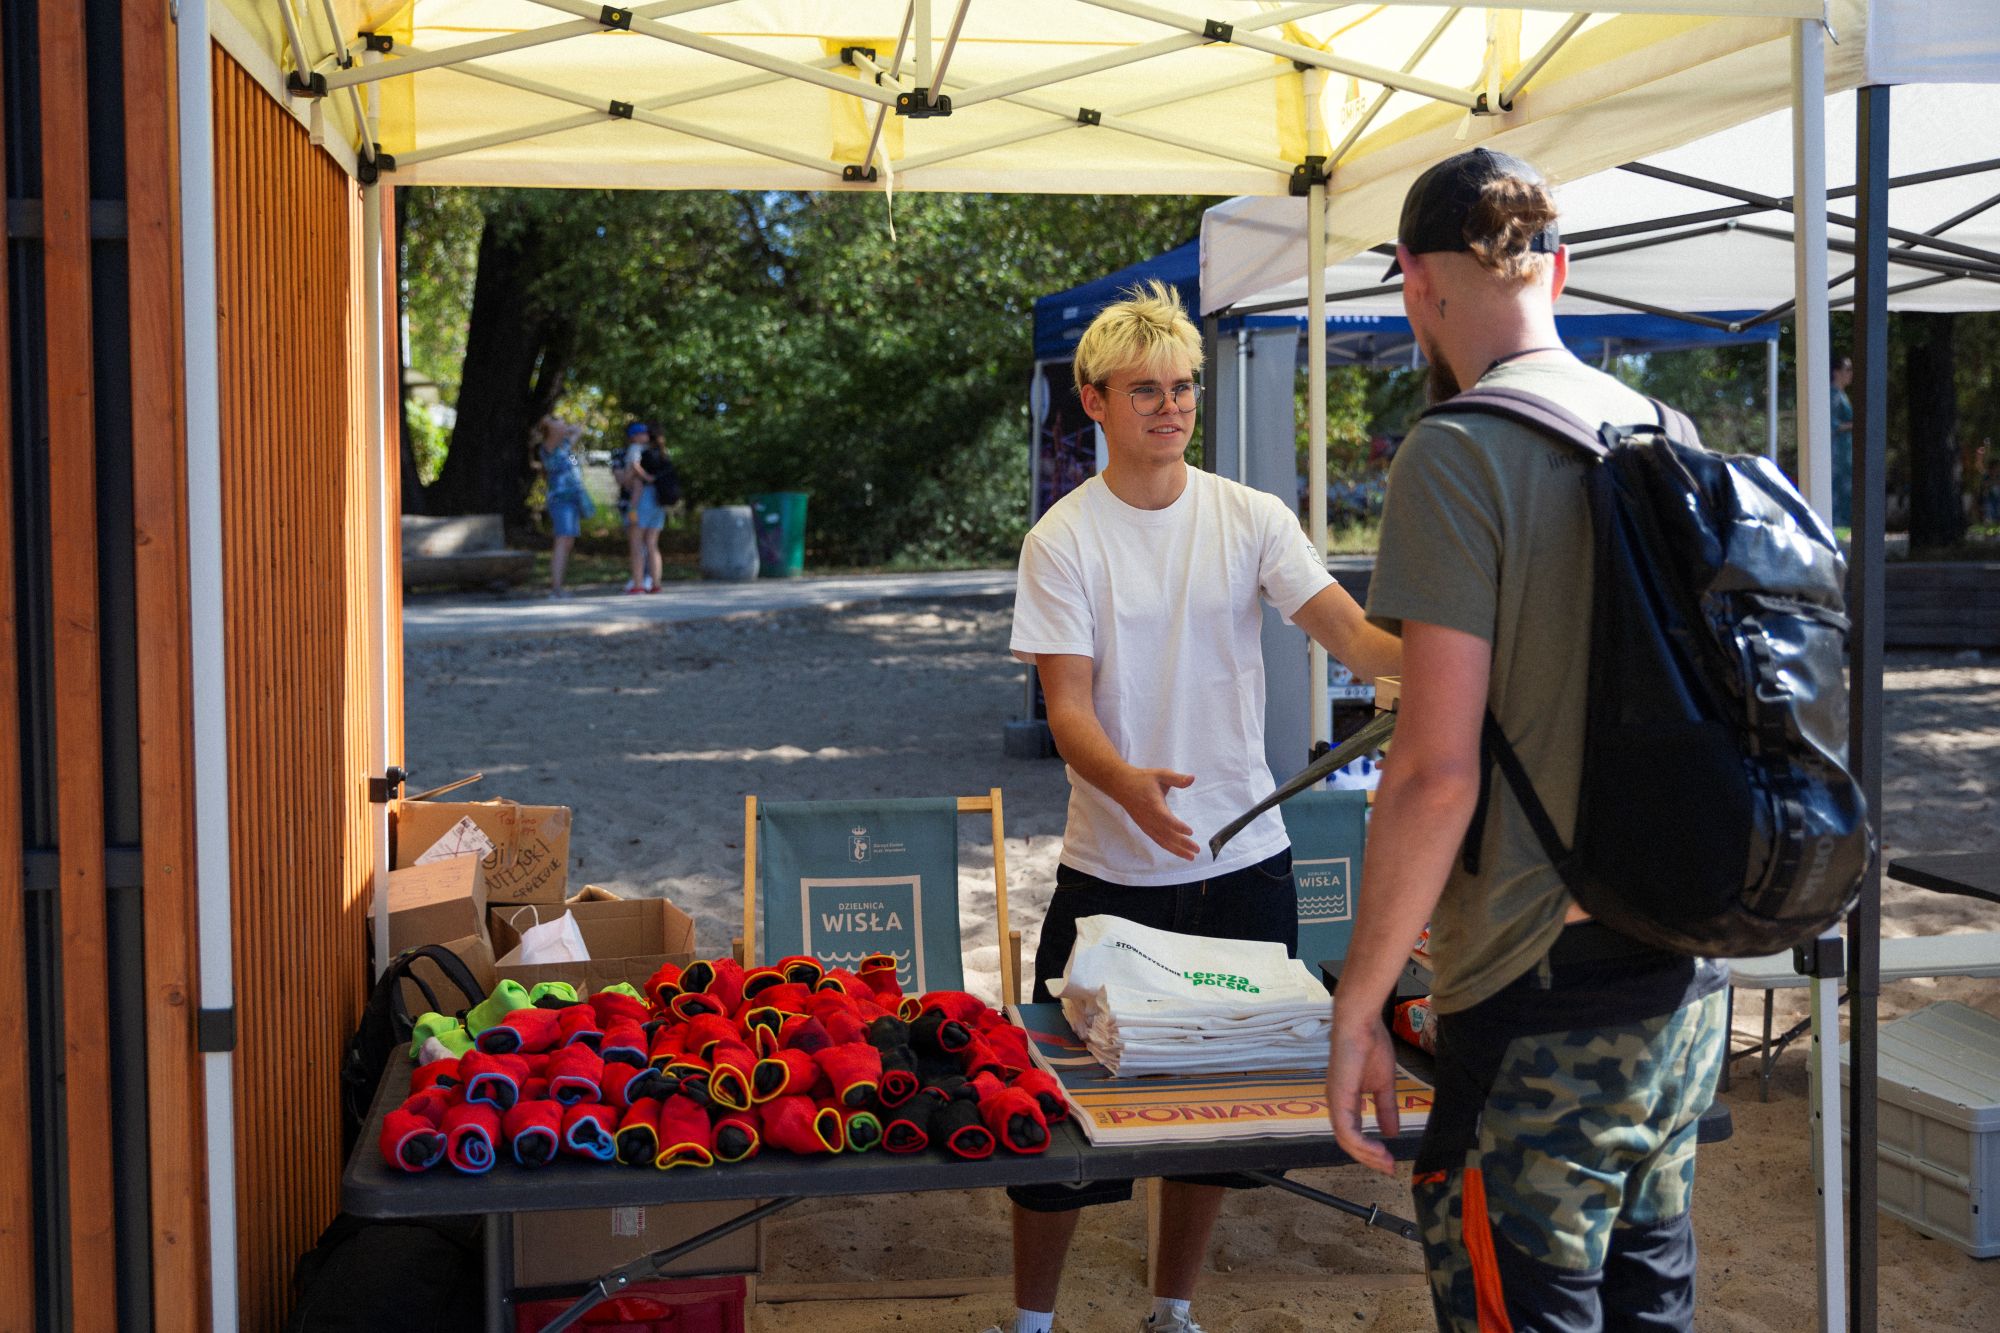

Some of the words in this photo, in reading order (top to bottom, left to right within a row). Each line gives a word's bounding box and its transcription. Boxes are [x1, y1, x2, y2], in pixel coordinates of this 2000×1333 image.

[1298, 875, 1341, 888] WISŁA
[838, 901, 885, 911] DZIELNICA
[821, 911, 903, 932] WISŁA
[1115, 941, 1182, 977] STOWARZYSZENIE
